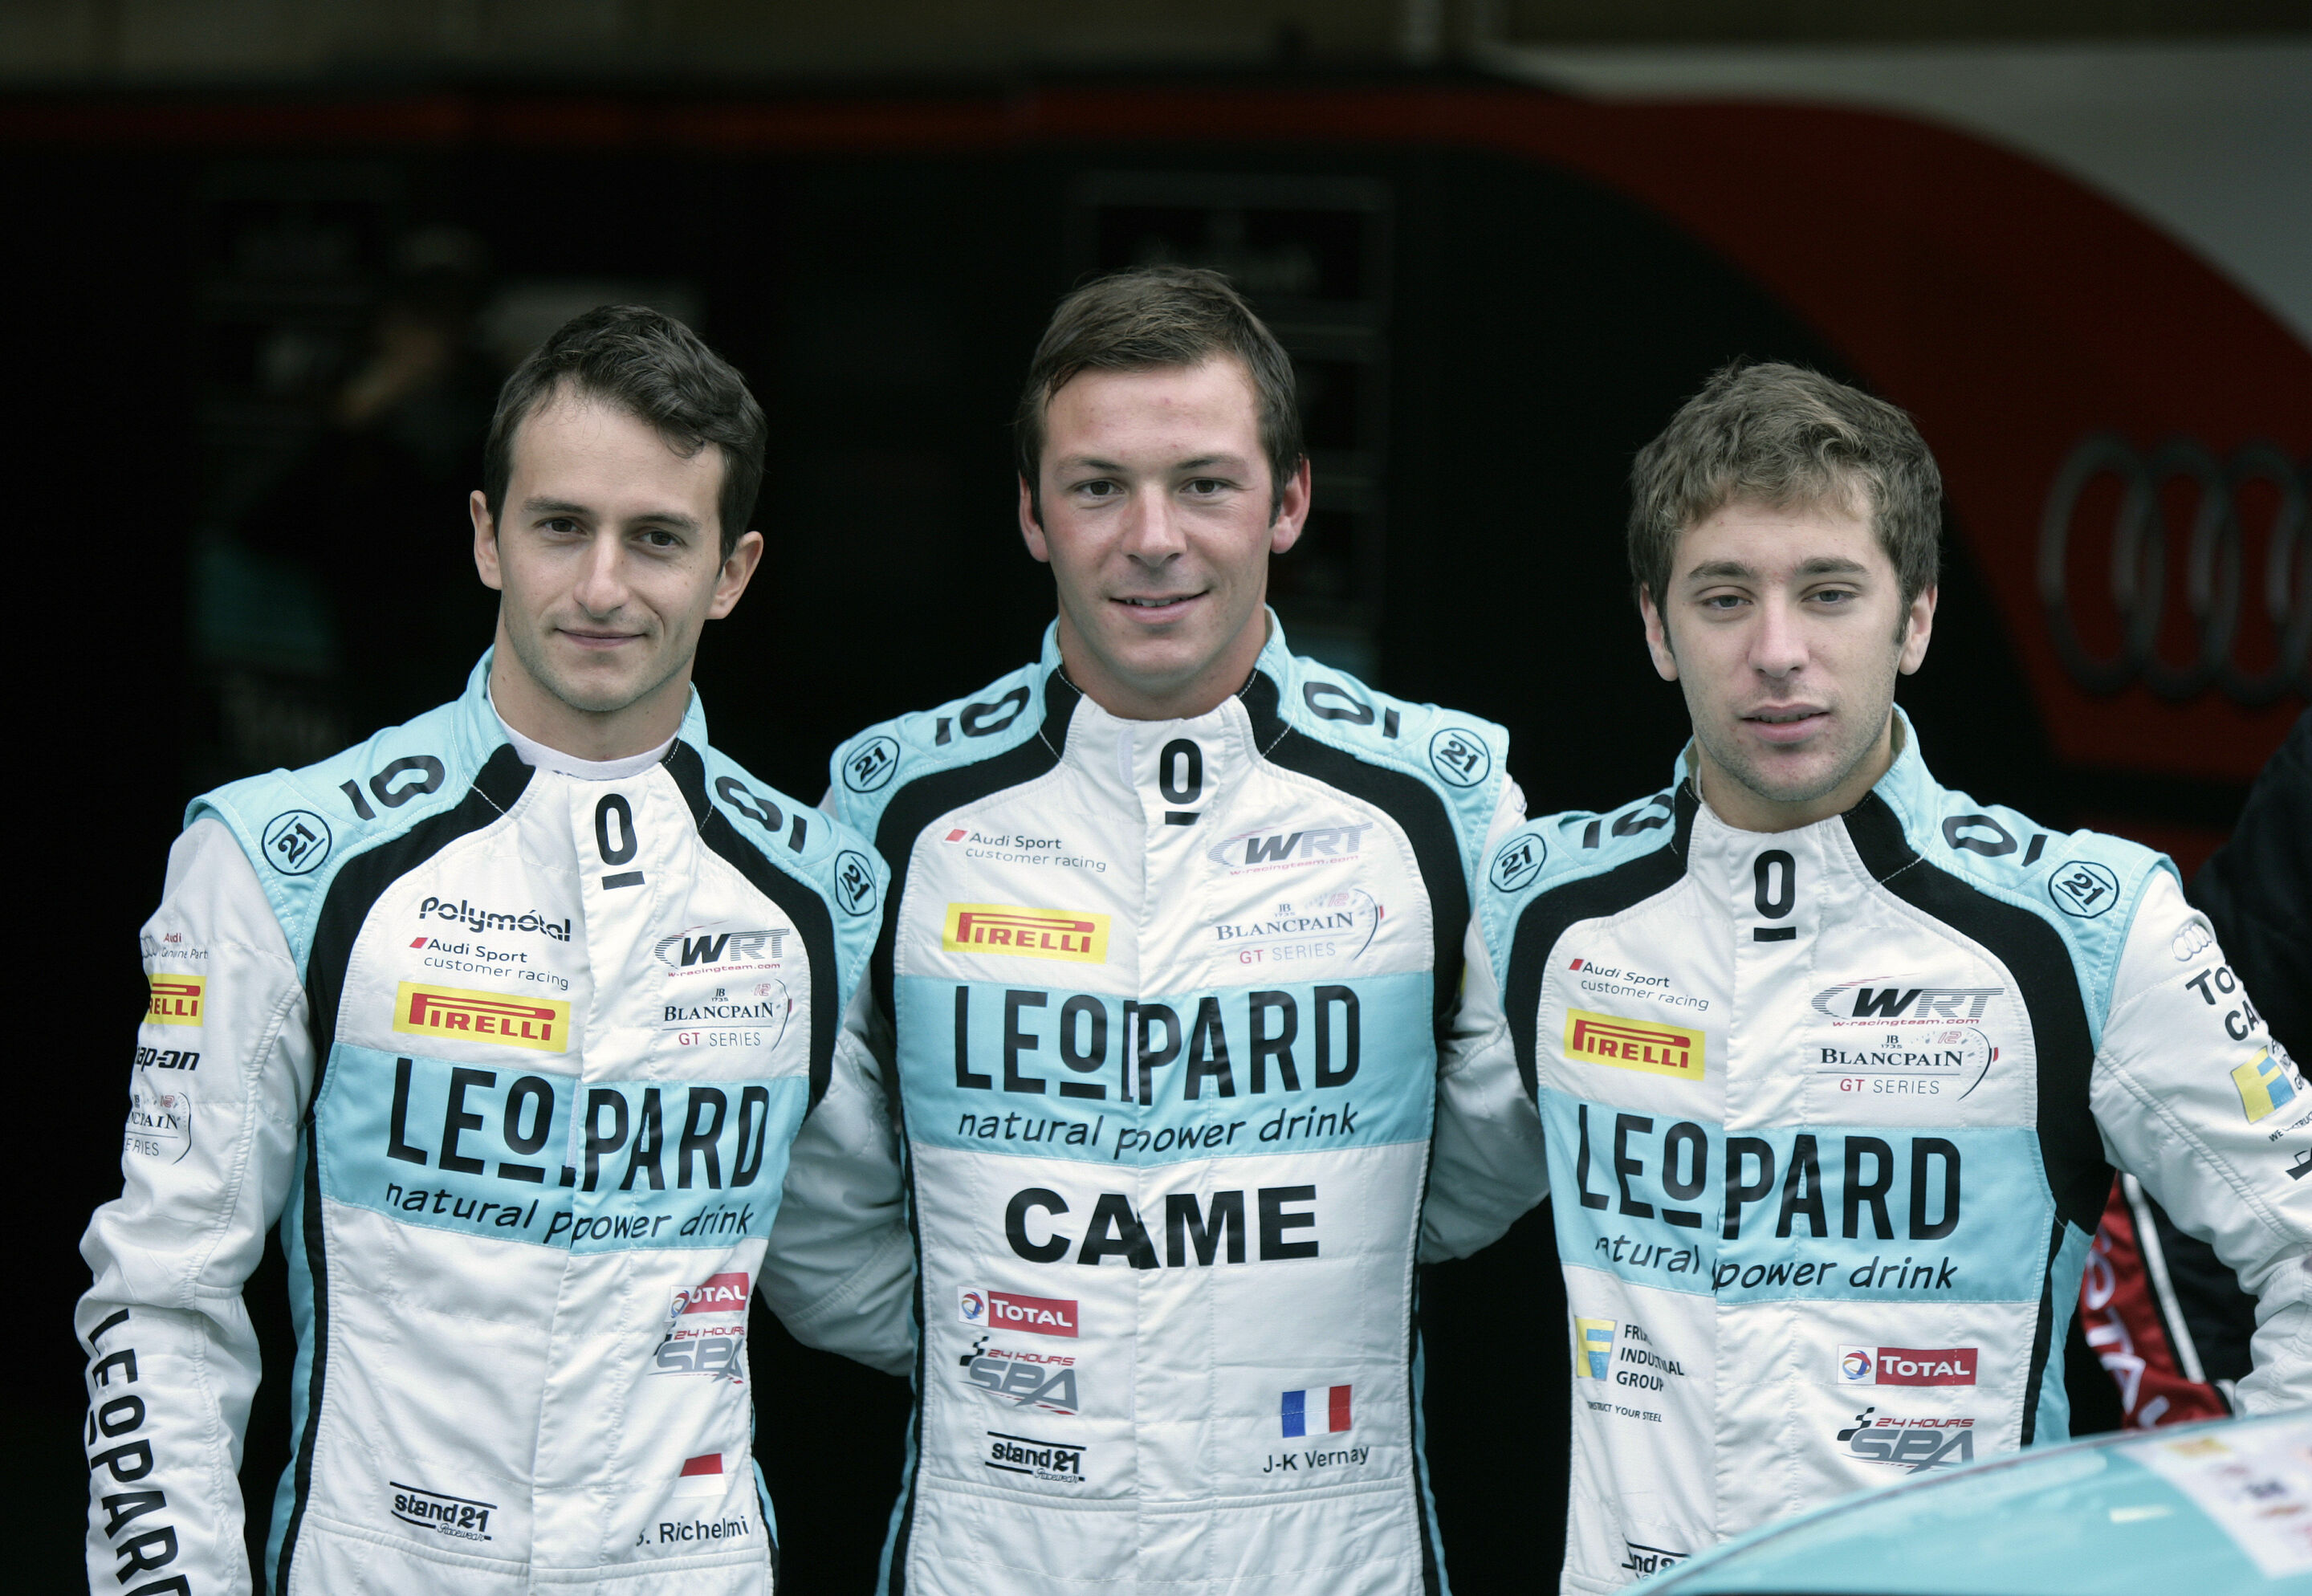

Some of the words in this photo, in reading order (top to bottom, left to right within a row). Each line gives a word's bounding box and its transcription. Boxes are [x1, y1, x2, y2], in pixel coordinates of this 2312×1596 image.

[854, 747, 888, 783] 21
[1441, 740, 1478, 773] 21
[278, 823, 317, 864] 21
[969, 833, 1010, 846] Audi
[1015, 836, 1062, 850] Sport
[1245, 822, 1374, 865] WRT
[966, 848, 1049, 865] customer
[1055, 856, 1106, 873] racing
[1501, 844, 1532, 879] 21
[843, 865, 870, 902] 21
[2062, 873, 2106, 906] 21
[164, 933, 181, 943] Audi
[956, 912, 1095, 953] PIRELLI
[1216, 912, 1353, 941] BLANCPAIN
[427, 938, 470, 955] Audi
[475, 946, 527, 963] Sport
[681, 929, 790, 967] WRT
[1239, 950, 1264, 964] GT
[1272, 943, 1336, 961] SERIES
[424, 957, 512, 977] customer
[518, 970, 568, 991] racing
[1582, 962, 1621, 978] Audi
[1624, 971, 1670, 987] Sport
[664, 1002, 774, 1022] BLANCPAIN
[1581, 979, 1655, 999] customer
[1658, 995, 1709, 1012] racing
[1852, 988, 2005, 1018] WRT
[409, 992, 556, 1040] PIRELLI
[1833, 1019, 1980, 1027] w-racingteam.com
[678, 1032, 700, 1045] GT
[709, 1032, 761, 1046] SERIES
[955, 984, 1361, 1106] LEOPARD
[1573, 1019, 1691, 1069] PIRELLI
[1821, 1048, 1964, 1066] BLANCPAIN
[1840, 1079, 1865, 1092] GT
[1873, 1080, 1940, 1094] SERIES
[387, 1057, 770, 1192] LEOPARD
[959, 1112, 1104, 1147] natural
[1259, 1102, 1359, 1142] drink
[1577, 1104, 1961, 1240] LEOPARD
[386, 1183, 538, 1229] natural
[680, 1204, 754, 1237] drink
[1005, 1183, 1319, 1269] CAME
[1715, 1261, 1837, 1291] power
[1849, 1256, 1958, 1290] drink
[692, 1285, 747, 1305] OTAL
[991, 1299, 1073, 1327] TOTAL
[674, 1327, 699, 1340] 24
[702, 1325, 745, 1337] HOURS
[657, 1338, 743, 1382] SPA
[987, 1349, 1012, 1358] 24
[1014, 1352, 1076, 1366] HOURS
[1879, 1356, 1971, 1376] TOTAL
[970, 1357, 1079, 1411] SPA
[1615, 1405, 1641, 1419] YOUR
[1642, 1411, 1663, 1423] STEEL
[1875, 1418, 1906, 1427] 24
[1908, 1419, 1975, 1428] HOURS
[1263, 1453, 1299, 1473] J-K
[1305, 1446, 1370, 1468] Vernay
[1850, 1428, 1975, 1476] SPA
[659, 1516, 749, 1544] Richelmi
